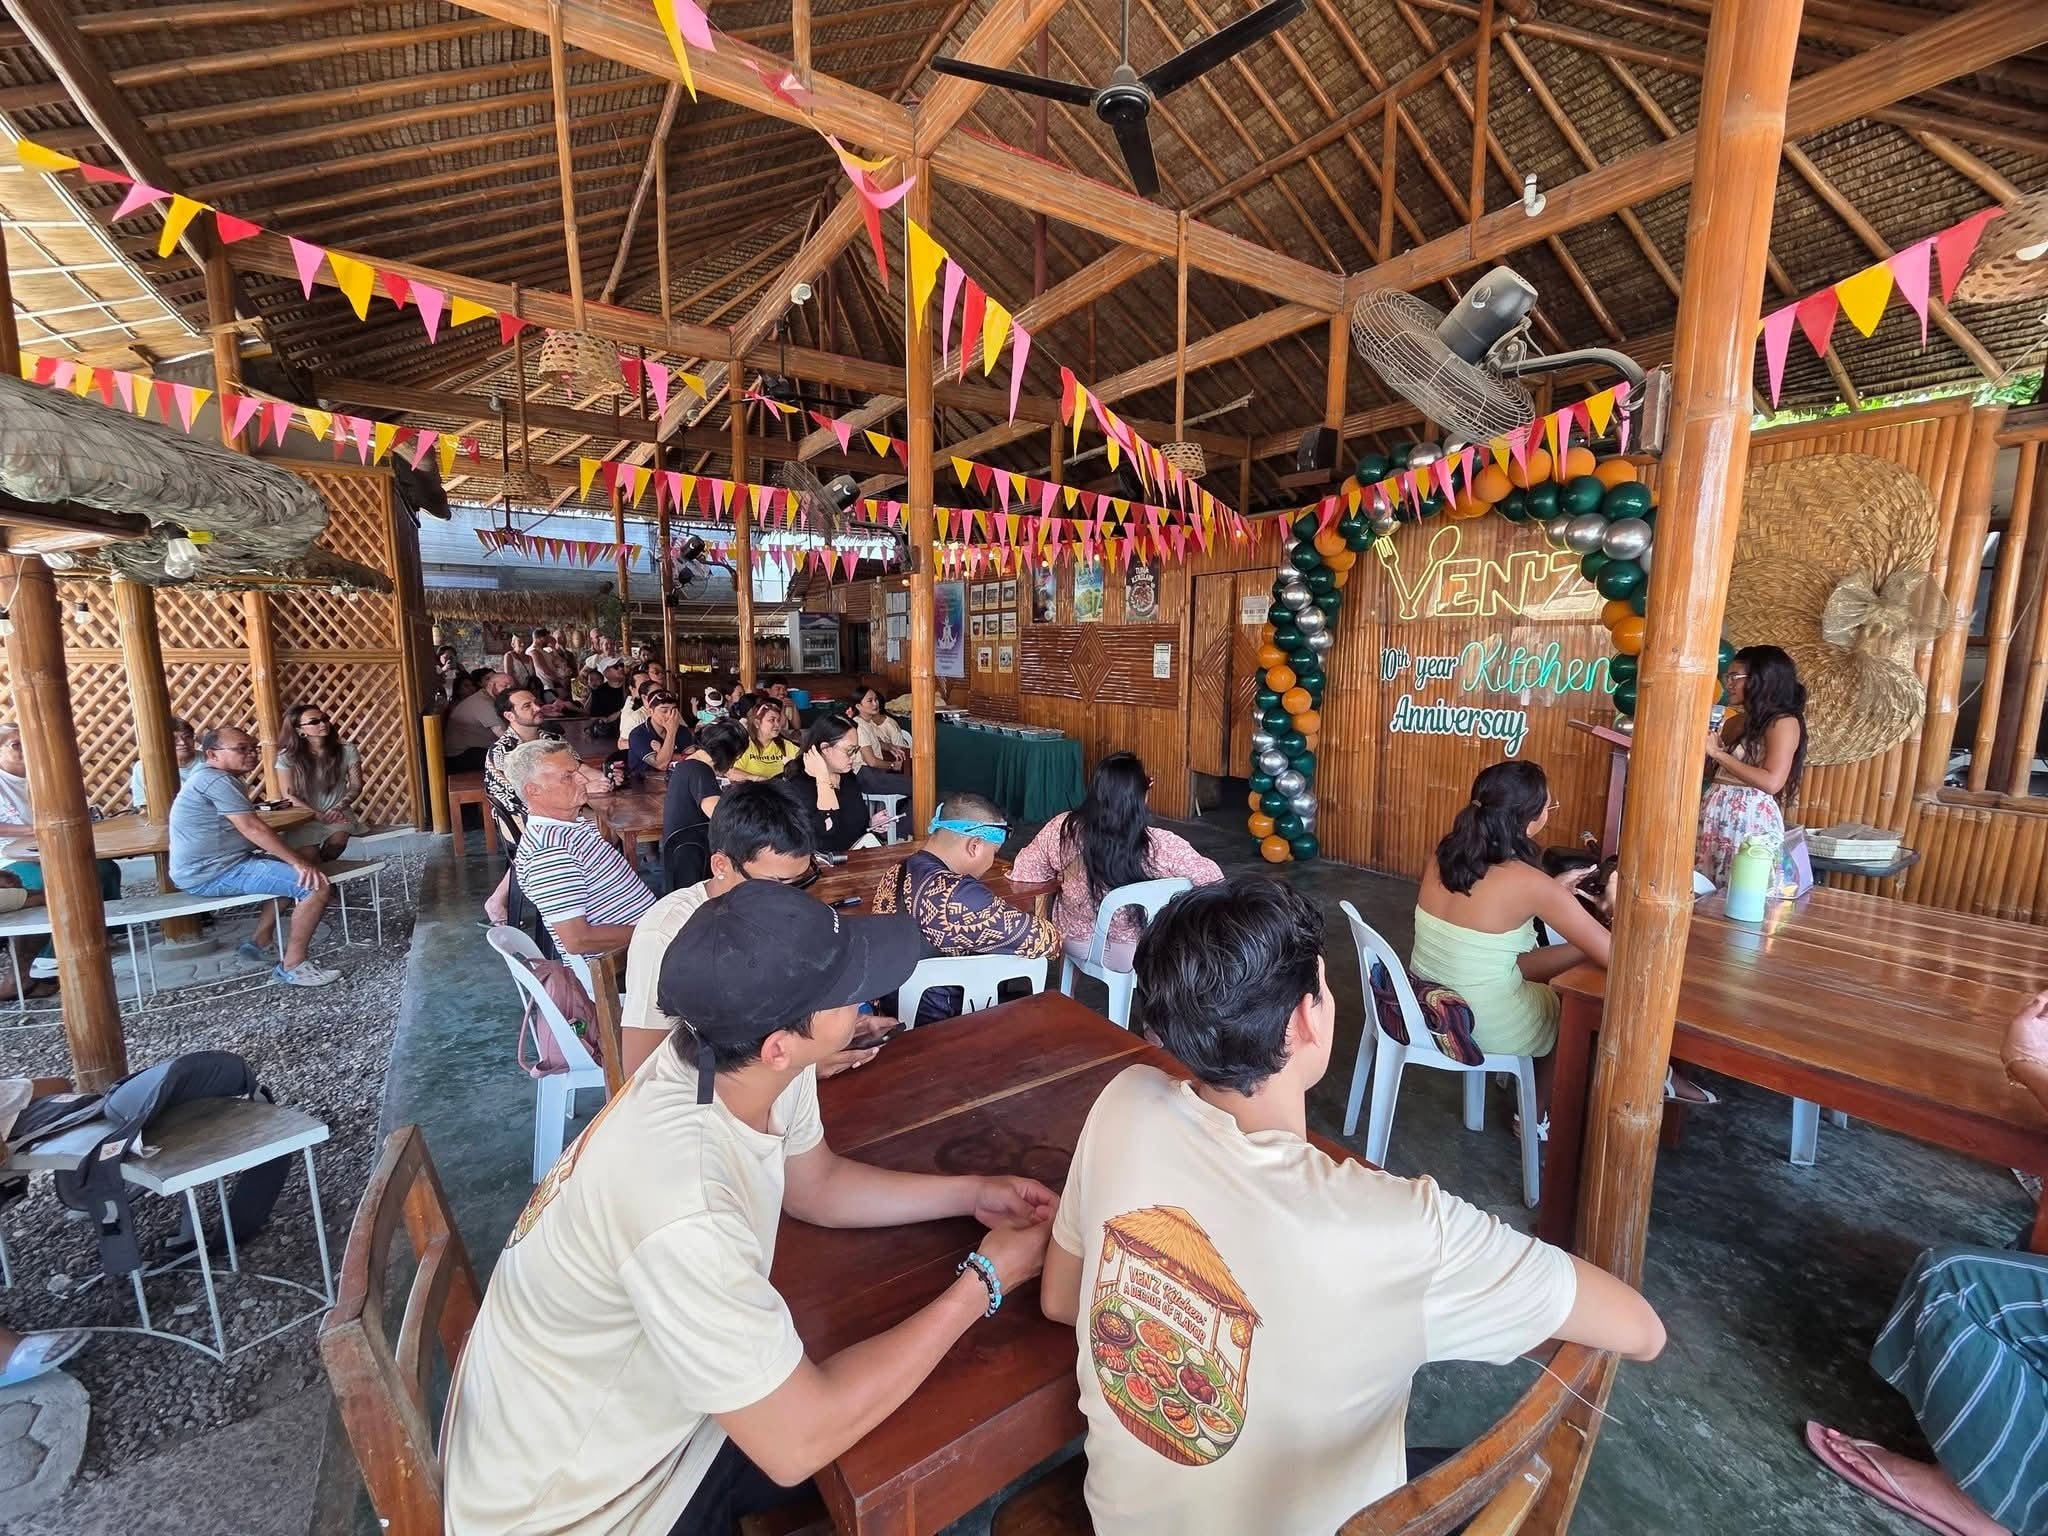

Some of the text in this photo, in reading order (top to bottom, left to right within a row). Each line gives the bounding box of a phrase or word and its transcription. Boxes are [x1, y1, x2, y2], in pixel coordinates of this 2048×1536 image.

[1381, 645, 1459, 690] 10th year
[1459, 641, 1619, 694] Kitchen
[1389, 695, 1528, 757] Anniversay
[1123, 1282, 1206, 1345] A DECADE OF FLAVOR
[1162, 1283, 1207, 1326] Kitchen:
